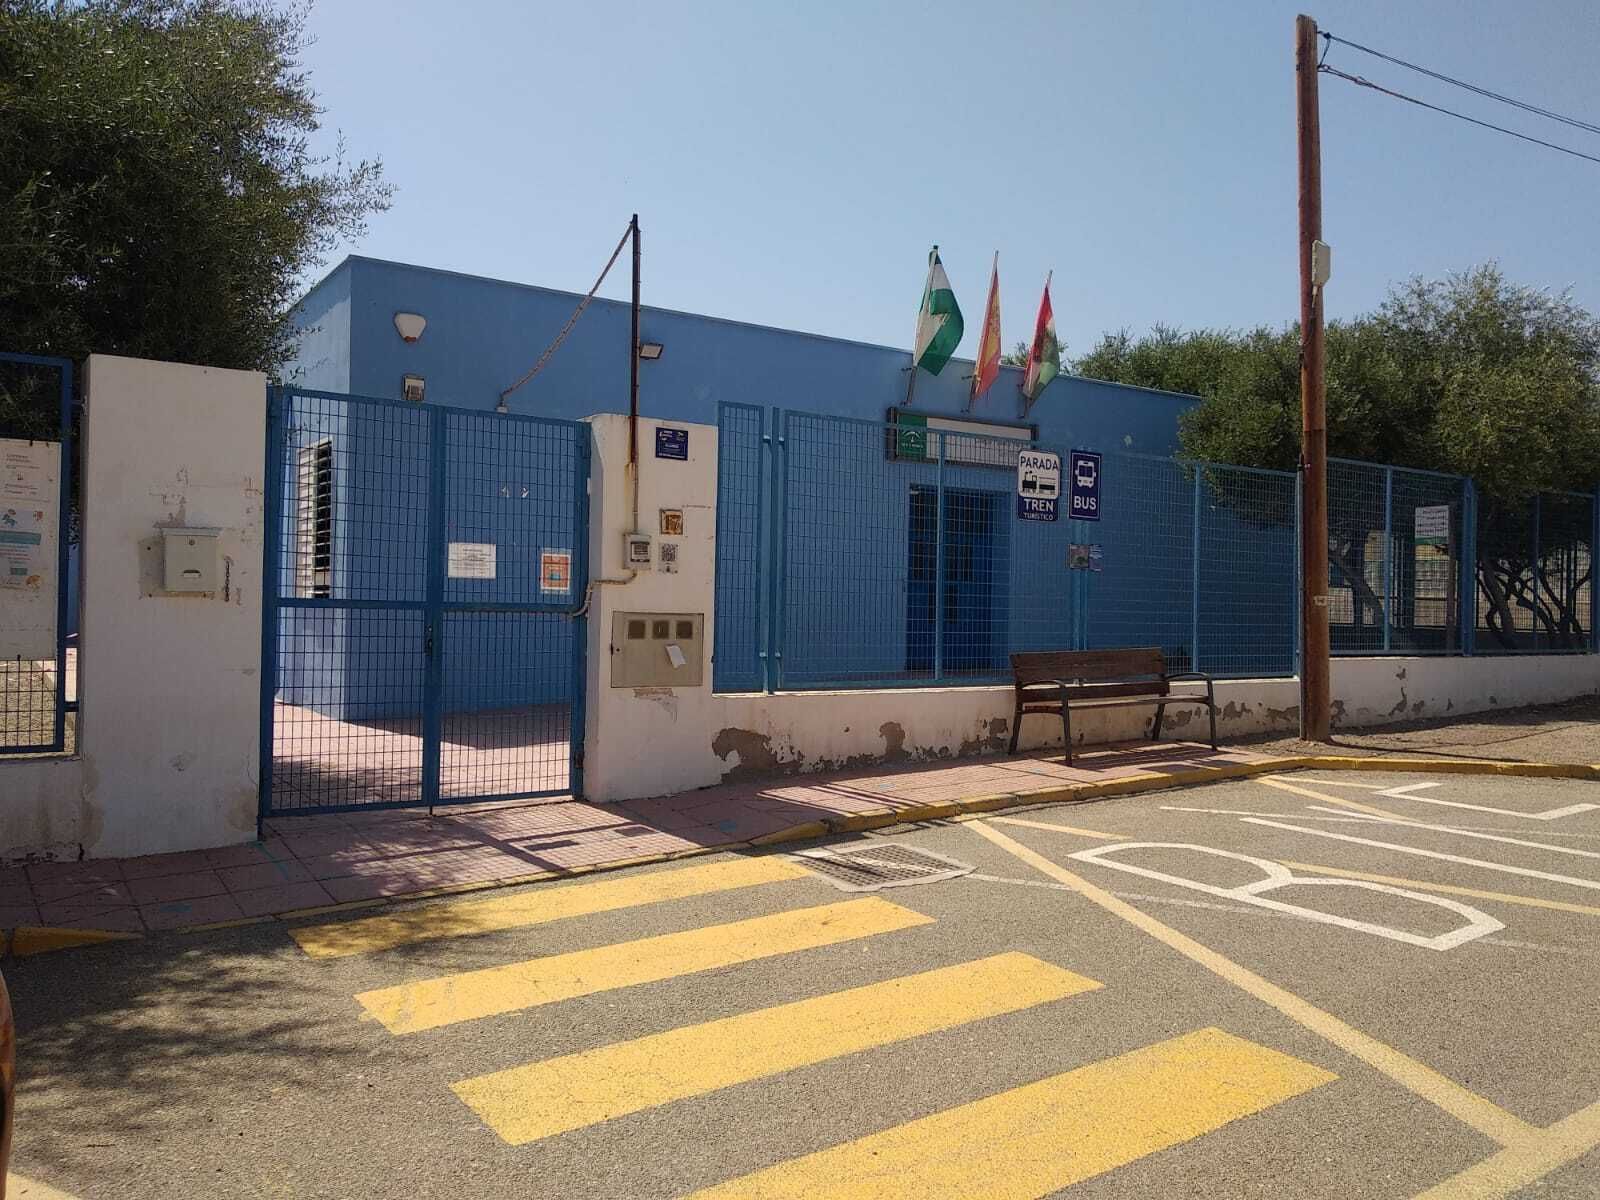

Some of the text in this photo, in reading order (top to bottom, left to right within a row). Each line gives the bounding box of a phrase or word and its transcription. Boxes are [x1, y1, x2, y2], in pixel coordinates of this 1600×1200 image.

[1020, 456, 1058, 471] PARADA
[1023, 498, 1054, 512] TREN
[1073, 495, 1097, 510] BUS
